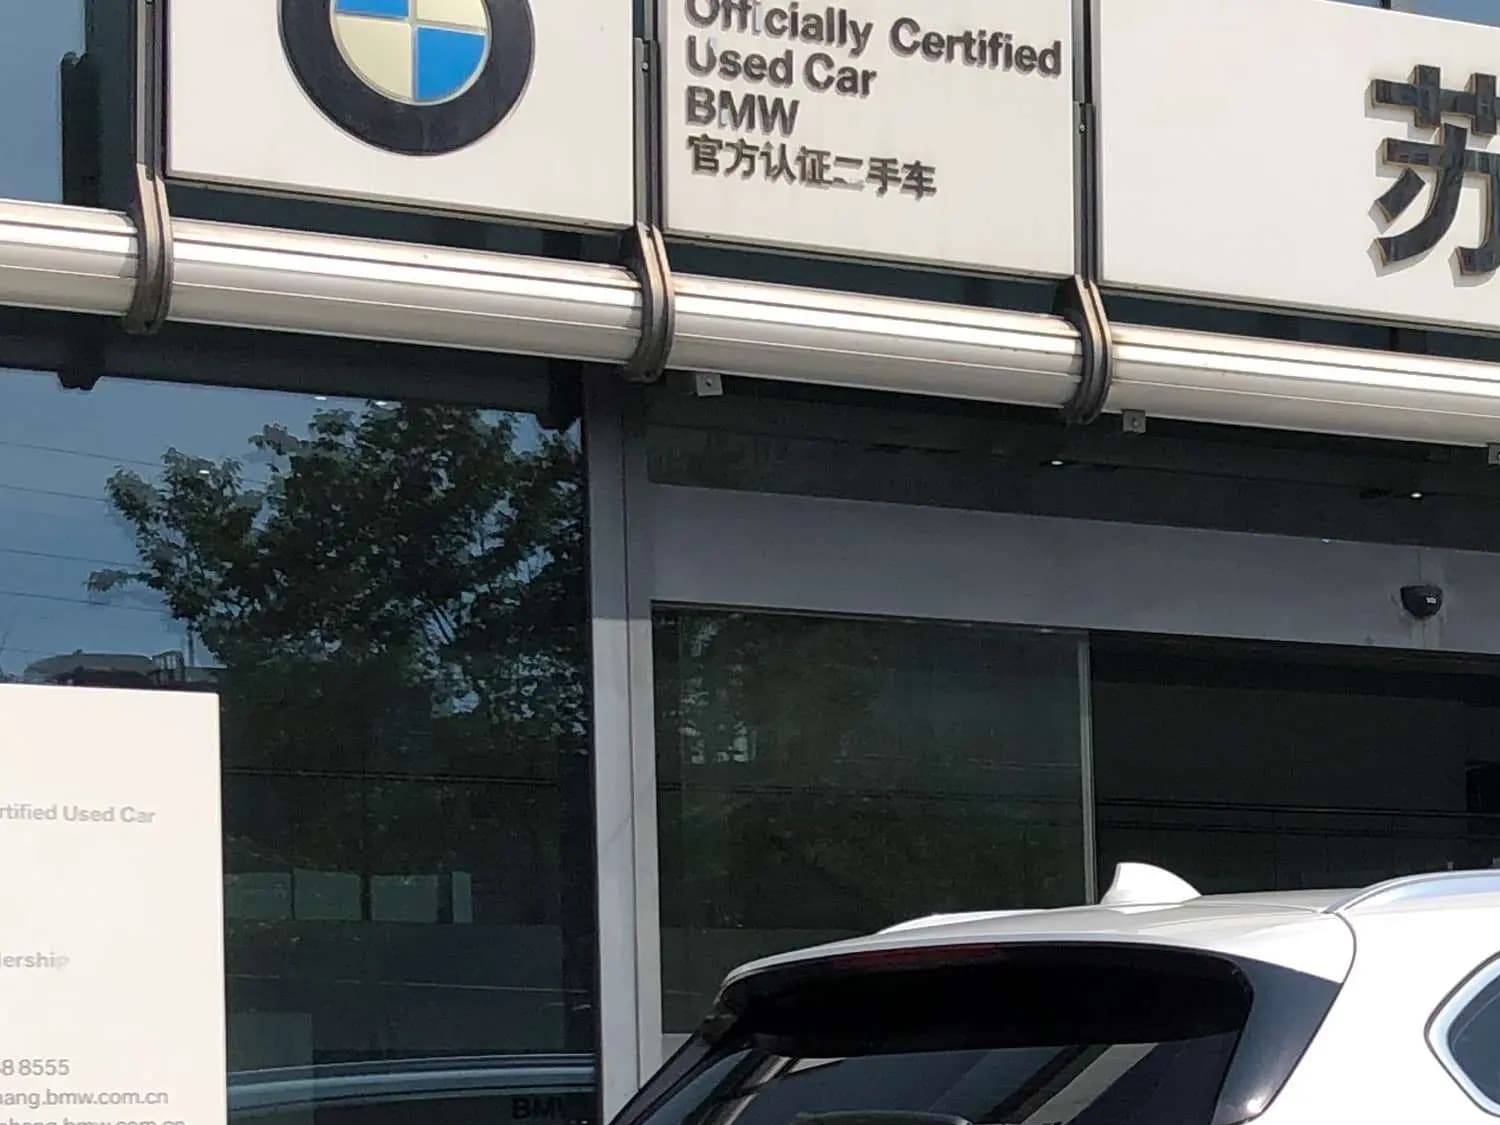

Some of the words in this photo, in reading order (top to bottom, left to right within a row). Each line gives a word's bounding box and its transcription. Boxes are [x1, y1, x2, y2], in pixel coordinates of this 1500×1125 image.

[685, 0, 874, 57] Officially
[889, 16, 1063, 76] Certified
[685, 34, 794, 87] Used
[803, 52, 878, 97] Car
[685, 85, 800, 137] BMW
[686, 134, 937, 200] 官方认证二手车
[63, 805, 115, 822] Used
[120, 806, 156, 823] Car
[18, 1059, 70, 1076] 8555
[0, 1089, 168, 1109] ang.bmw.com.cn
